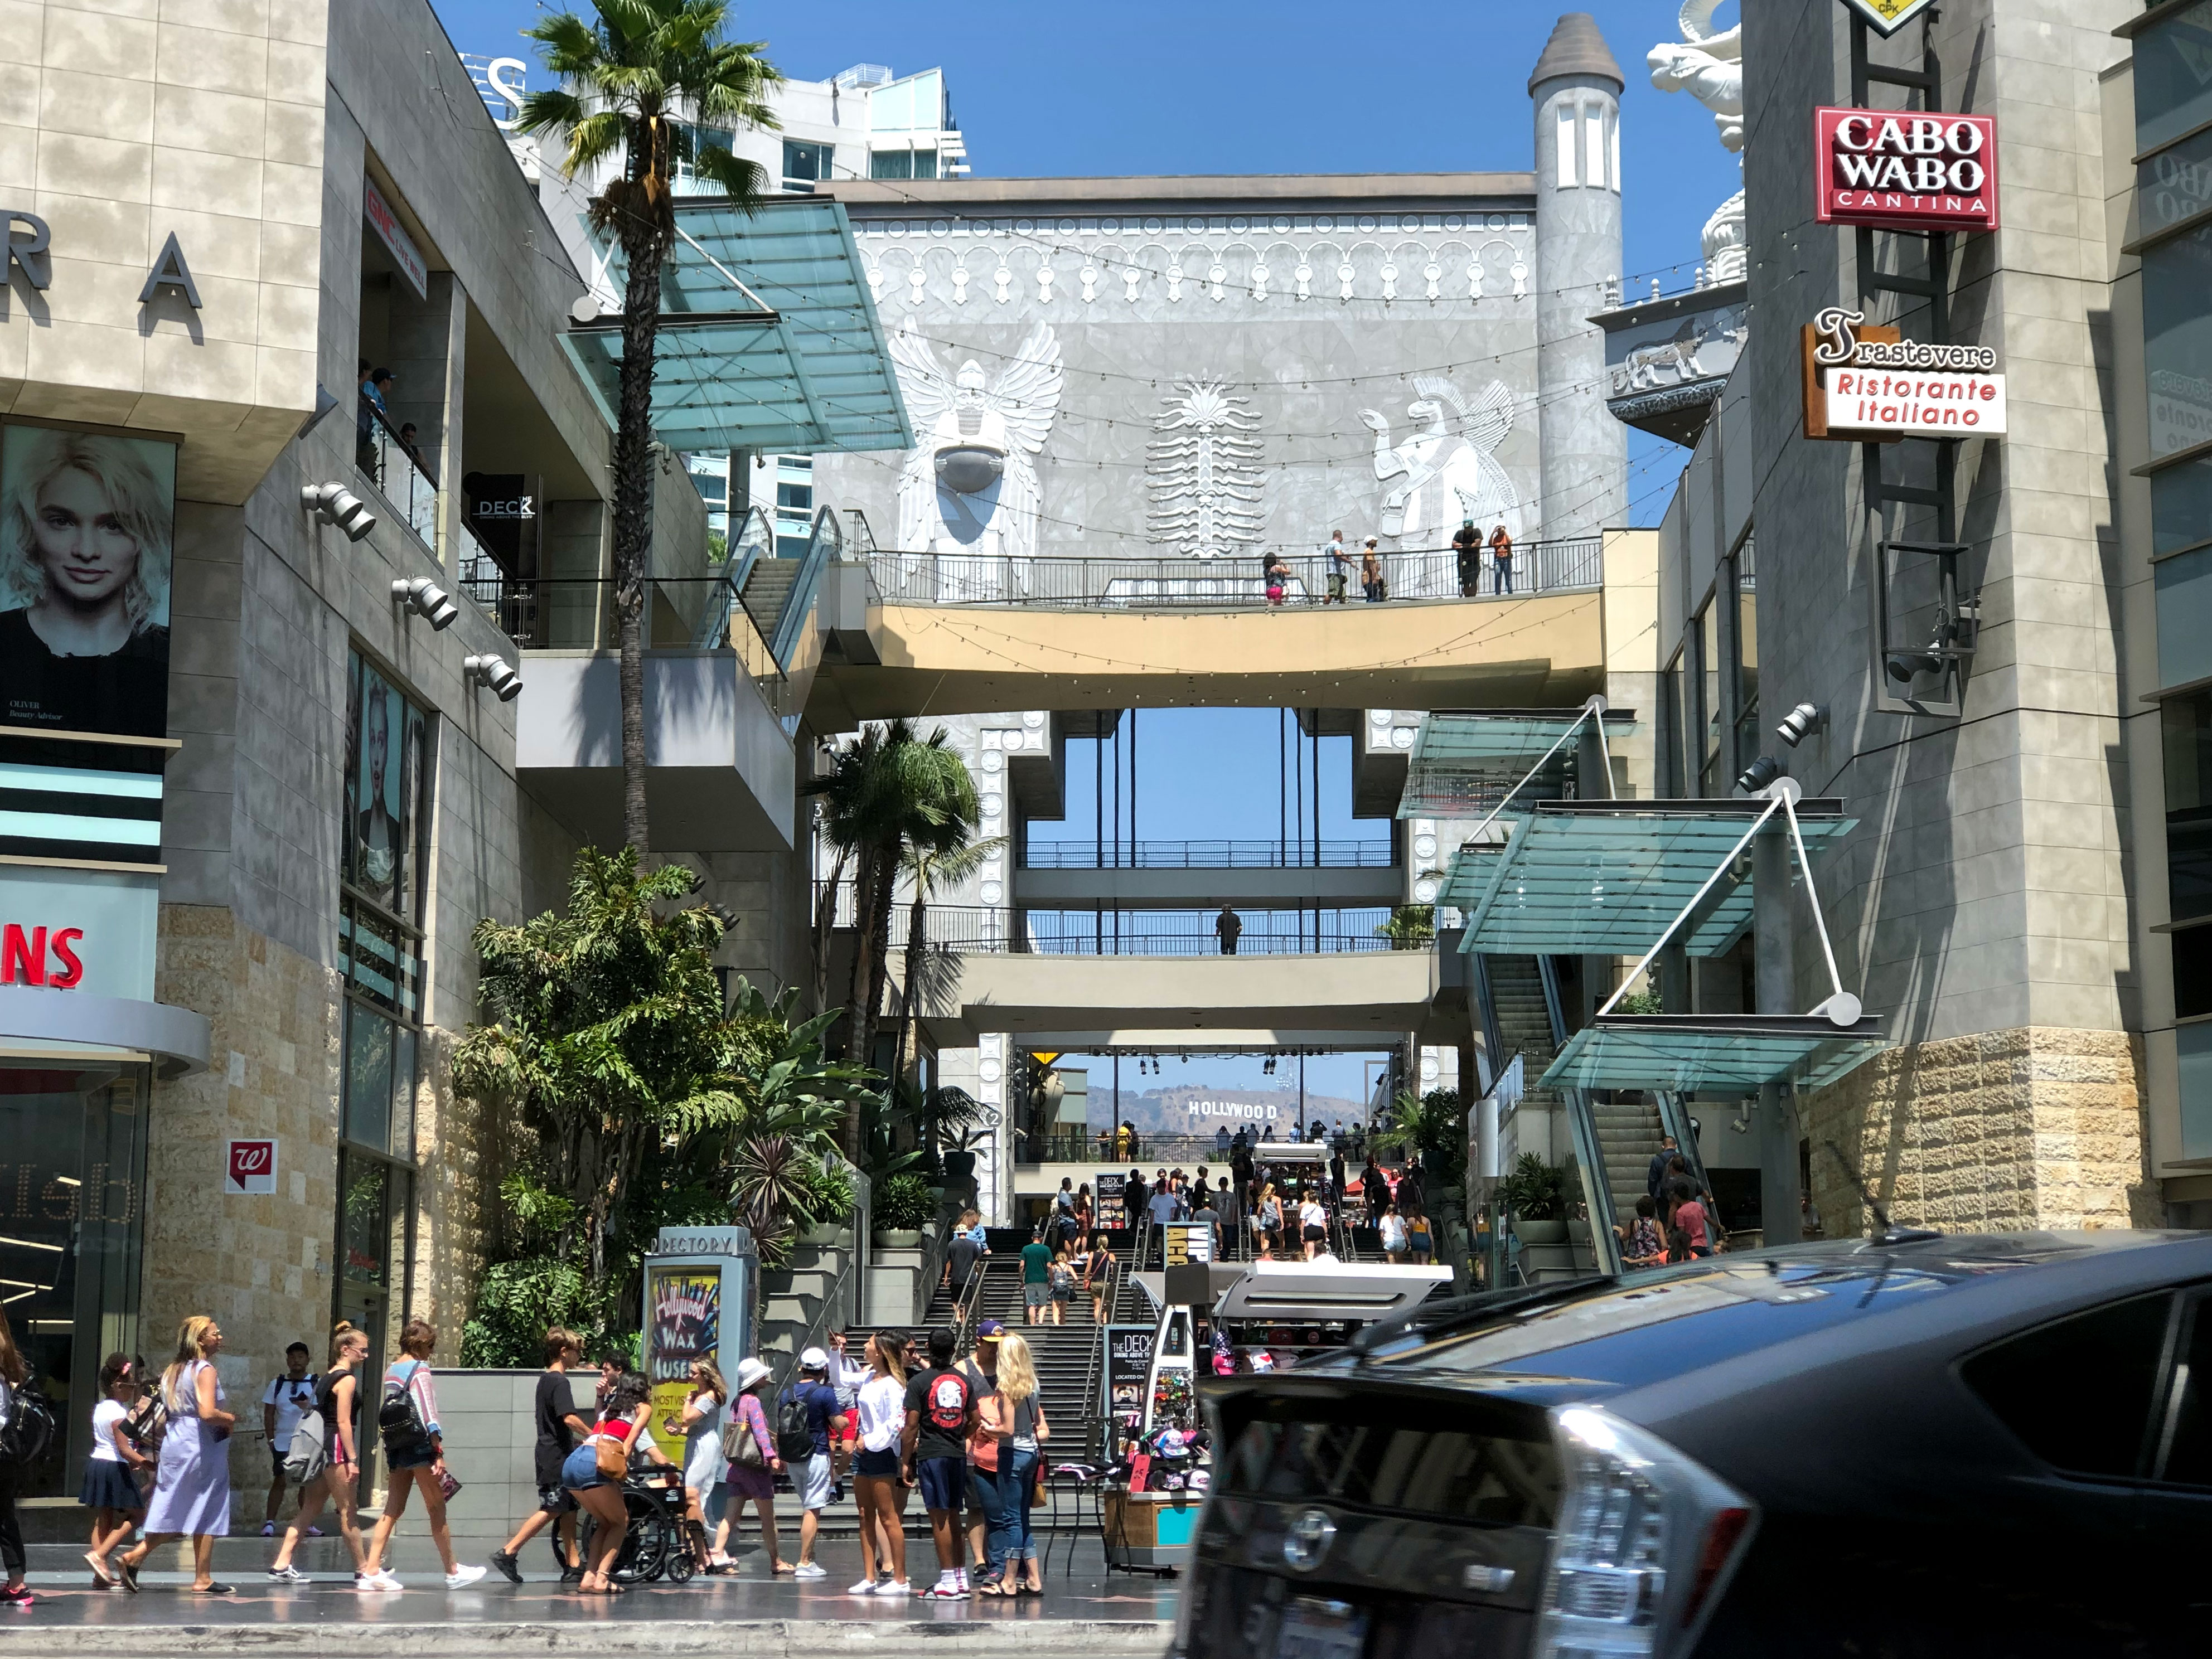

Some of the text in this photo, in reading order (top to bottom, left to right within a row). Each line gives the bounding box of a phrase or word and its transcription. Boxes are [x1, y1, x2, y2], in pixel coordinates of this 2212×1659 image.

[1878, 4, 1899, 14] CPK
[1834, 115, 1985, 156] CABO
[1835, 153, 1986, 192] WABO
[1838, 192, 1987, 212] CANTINA
[367, 188, 425, 290] GNC LIVE WELL
[1814, 307, 1996, 368] Trastevere
[1838, 373, 1997, 401] Ristorante
[1857, 400, 1980, 426] Italiano
[480, 501, 533, 513] DECK
[9, 700, 40, 709] OLIVER
[9, 710, 63, 721] Beauty Advisor
[814, 803, 823, 817] 3
[1, 923, 84, 989] NS
[1189, 1101, 1277, 1119] HOLLYWOOD
[1104, 1177, 1119, 1185] DECK
[1188, 1228, 1209, 1262] VIP
[655, 1284, 709, 1331] Hollywood
[662, 1326, 696, 1350] WAX
[1112, 1335, 1154, 1352] THE DECK
[654, 1395, 674, 1405] MOST
